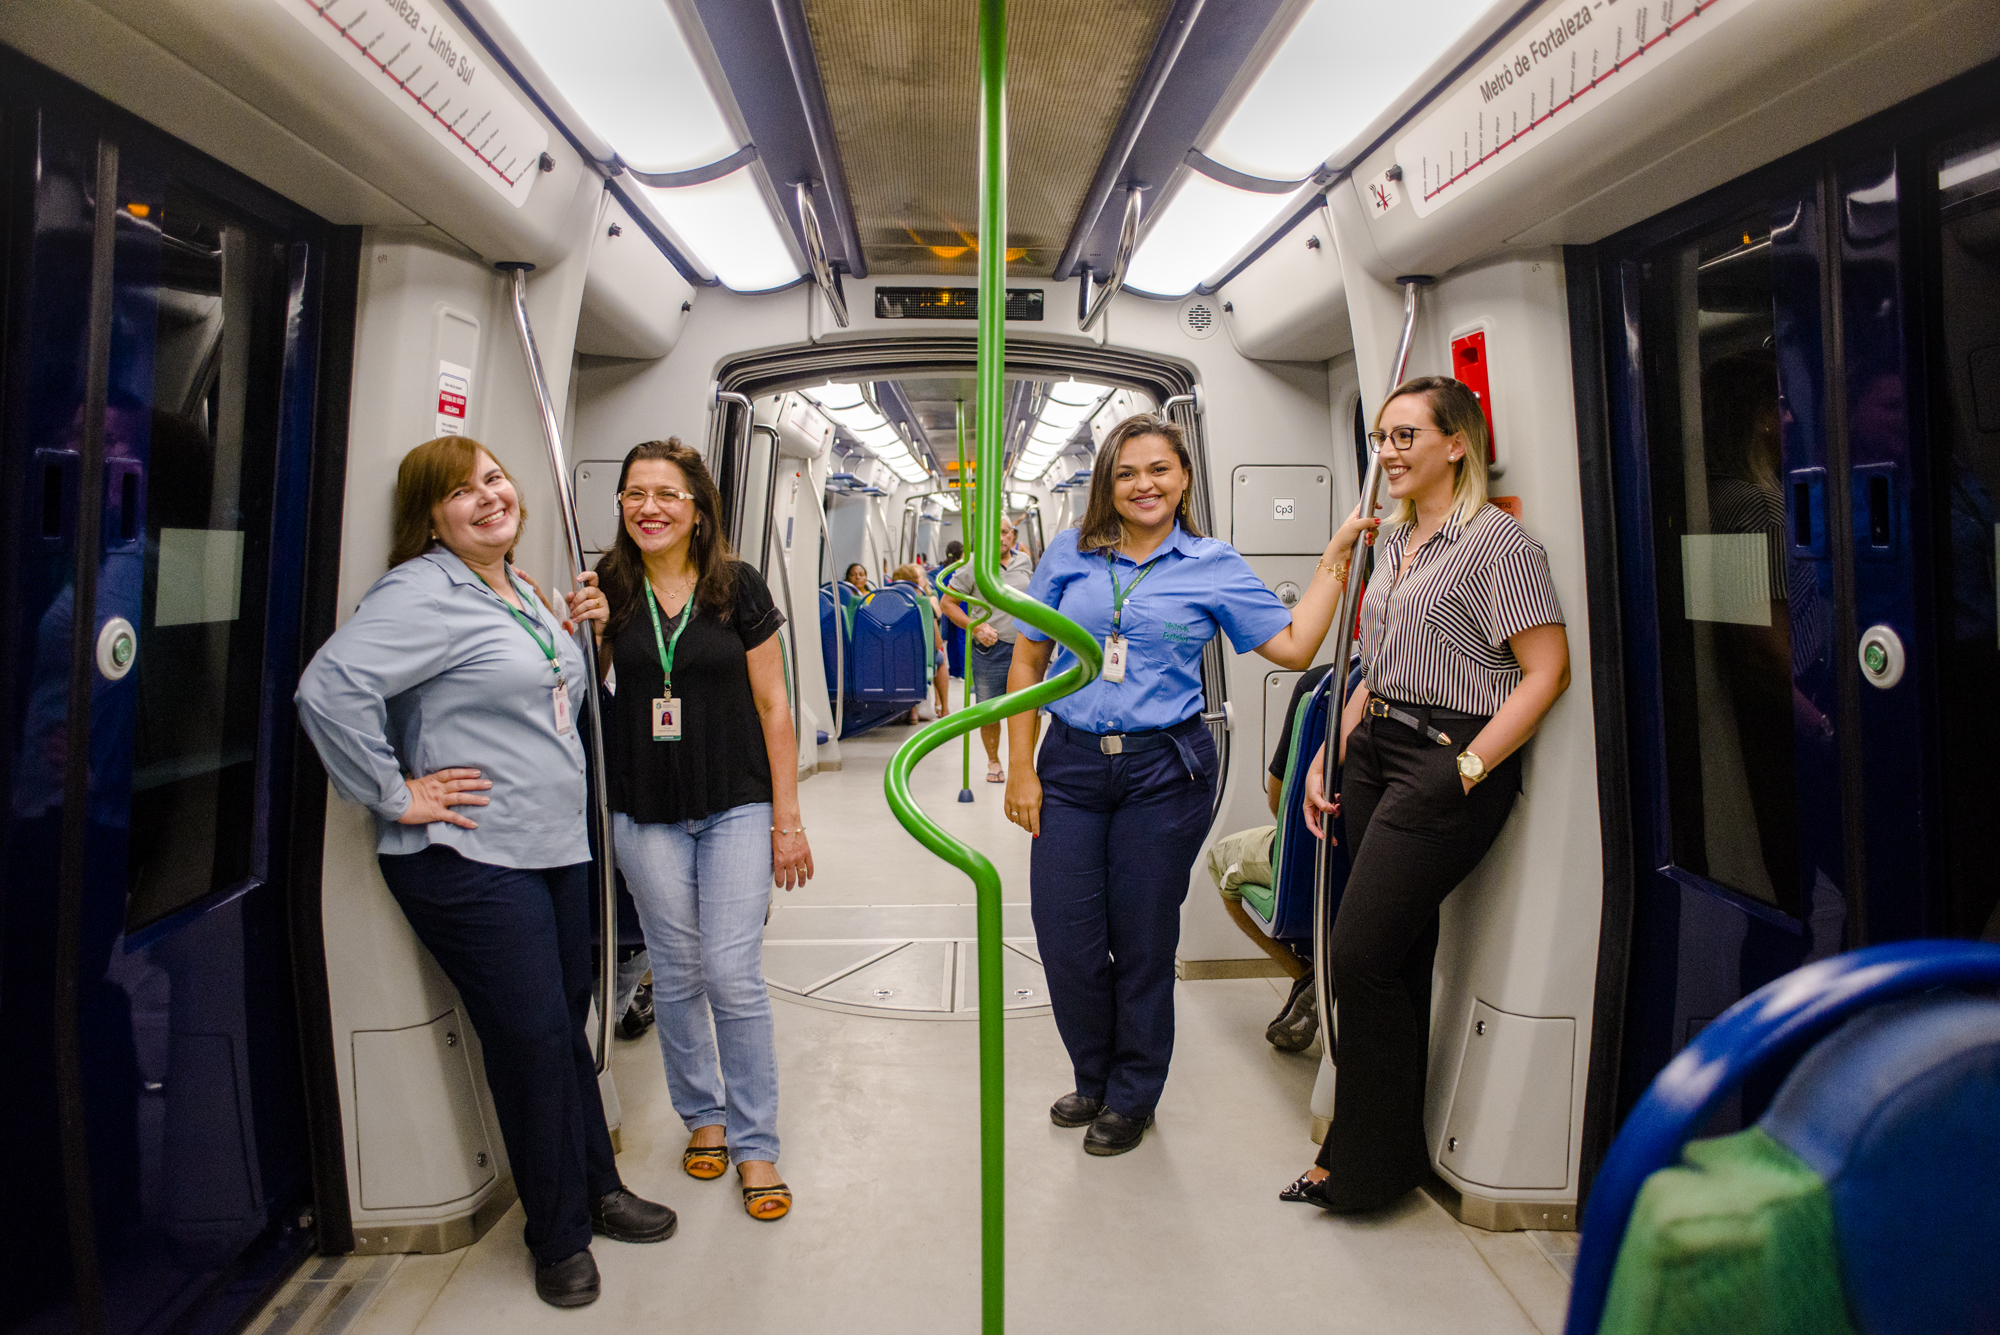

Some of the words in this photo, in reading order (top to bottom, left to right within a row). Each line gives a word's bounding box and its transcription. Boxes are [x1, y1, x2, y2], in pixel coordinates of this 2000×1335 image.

[428, 24, 457, 69] Linha
[456, 55, 475, 86] Sul
[1480, 64, 1513, 104] Metrô
[1514, 55, 1530, 78] de
[1529, 6, 1592, 64] Fortaleza
[1275, 505, 1293, 515] Cp3
